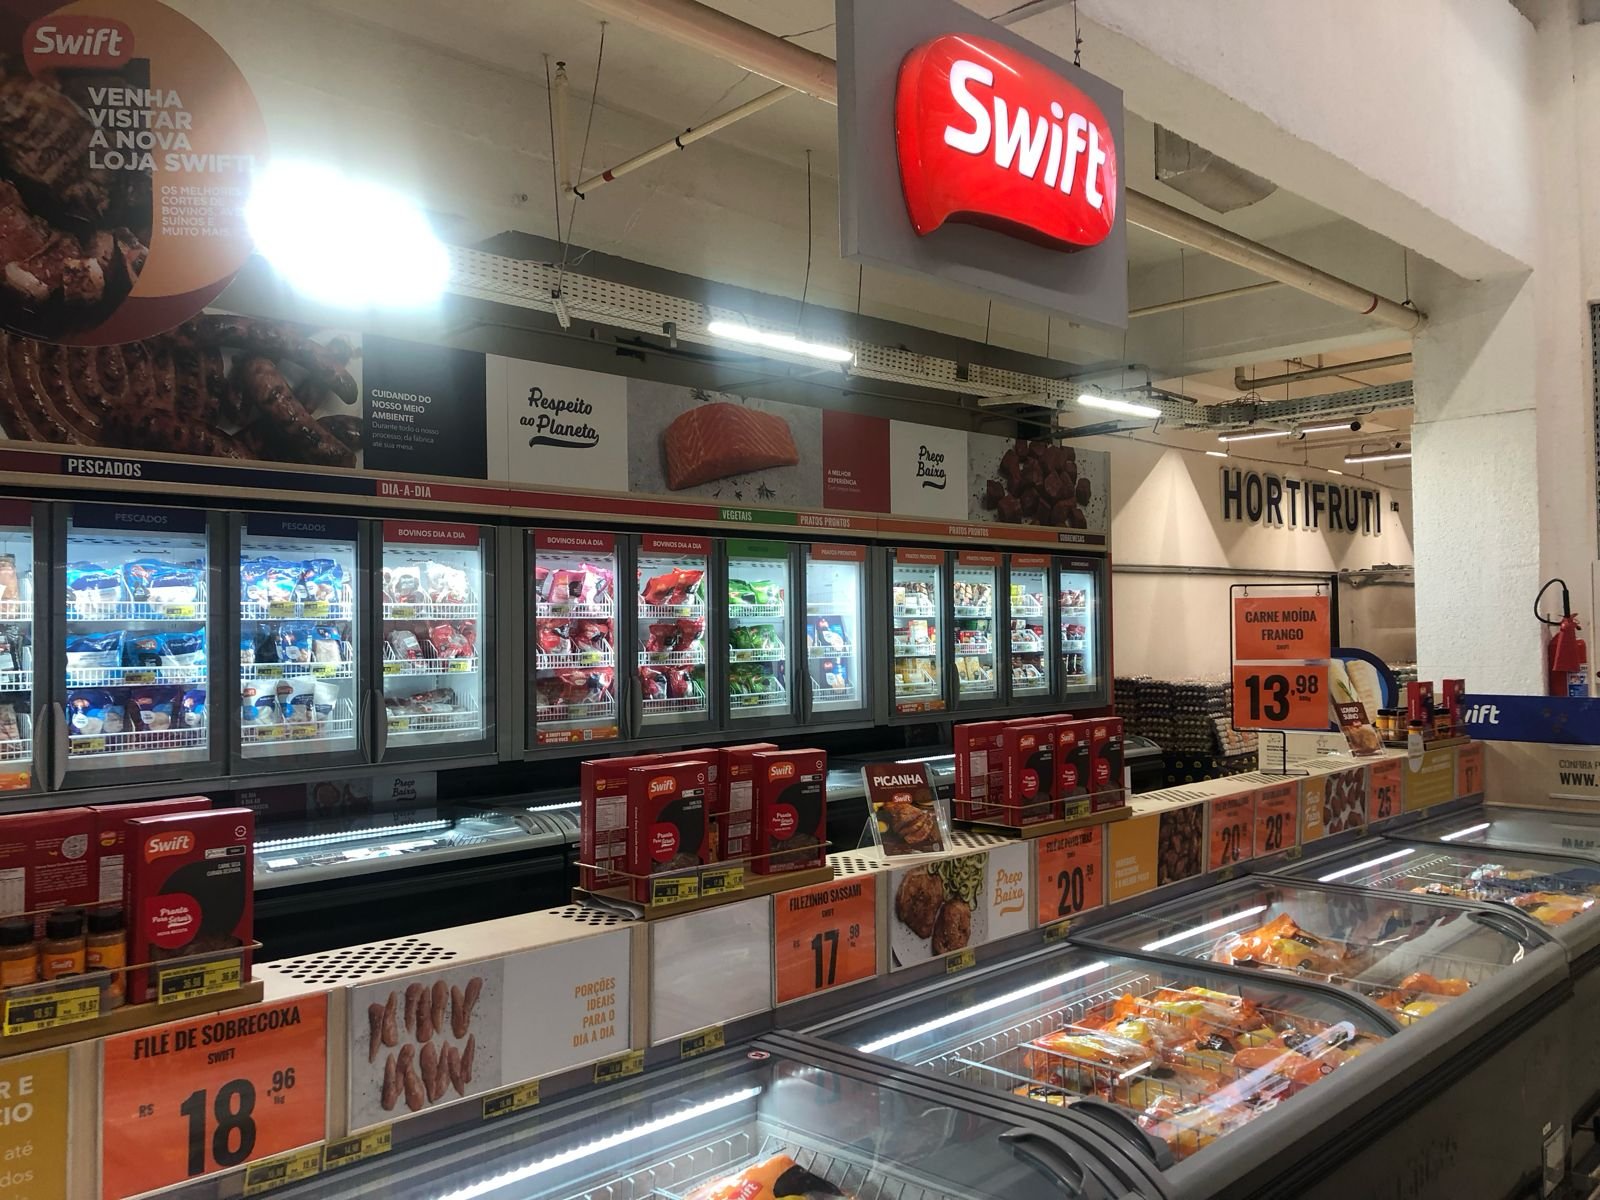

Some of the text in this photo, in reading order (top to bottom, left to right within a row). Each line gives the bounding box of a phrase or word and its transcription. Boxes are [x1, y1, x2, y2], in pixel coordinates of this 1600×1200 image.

[33, 26, 123, 57] Swift
[88, 86, 184, 109] VENHA
[88, 108, 193, 130] VISITAR
[88, 130, 192, 151] A NOVA
[944, 59, 1107, 210] Swift
[89, 150, 158, 171] LOJA
[161, 185, 178, 195] OS
[161, 195, 208, 206] CORTES
[162, 226, 199, 237] MUITO
[371, 389, 432, 404] CUIDANDO DO
[528, 386, 593, 416] Respeito
[372, 400, 425, 413] NOSSO MEIO
[372, 411, 415, 423] AMBIENTE
[519, 414, 599, 442] ao Planeta
[918, 445, 945, 466] Preço
[67, 457, 142, 478] PESCADOS
[916, 461, 946, 480] Baixo
[381, 481, 432, 498] DIA-A-DIA
[1221, 467, 1382, 536] HORTIFRUTI
[114, 512, 168, 525] PESCADOS
[722, 510, 753, 521] VEGETAIS
[800, 516, 851, 528] PRATOS PRONTOS
[281, 521, 326, 533] PESCADOS
[398, 528, 466, 539] BOVINOS DIA A DIA
[547, 537, 575, 545] BOVINOS
[653, 540, 677, 549] BOVINOS
[677, 541, 688, 549] DIA
[692, 542, 702, 550] DIA
[1245, 607, 1317, 623] CARNE MOÍDA
[1261, 628, 1304, 640] FRANGO
[1245, 674, 1319, 721] 13 ,98
[770, 765, 793, 776] Swift
[1559, 760, 1593, 770] CONFIRA
[650, 779, 674, 793] Swift
[873, 773, 924, 787] PICANHA
[894, 794, 911, 803] Swift
[1265, 813, 1283, 851] 28
[148, 835, 191, 853] Swift
[1222, 823, 1241, 865] 20
[996, 869, 1023, 887] Preço
[789, 883, 862, 912] FILEZINHO SASSAMI
[993, 887, 1024, 907] Baixo
[1057, 866, 1085, 917] 20
[51, 960, 73, 969] Swift
[811, 928, 840, 989] 17
[575, 977, 616, 998] PORÇÕES
[587, 993, 616, 1011] IDEAIS
[583, 1009, 615, 1028] PARA O
[134, 1006, 301, 1060] FILÉ DE SOBRECOXA
[573, 1025, 615, 1047] DIA A DIA
[207, 1048, 236, 1064] SWIFT
[19, 1075, 33, 1096] E
[138, 1104, 155, 1118] R$
[180, 1079, 256, 1177] 18
[266, 1067, 296, 1096] ,96
[4, 1140, 33, 1161] até
